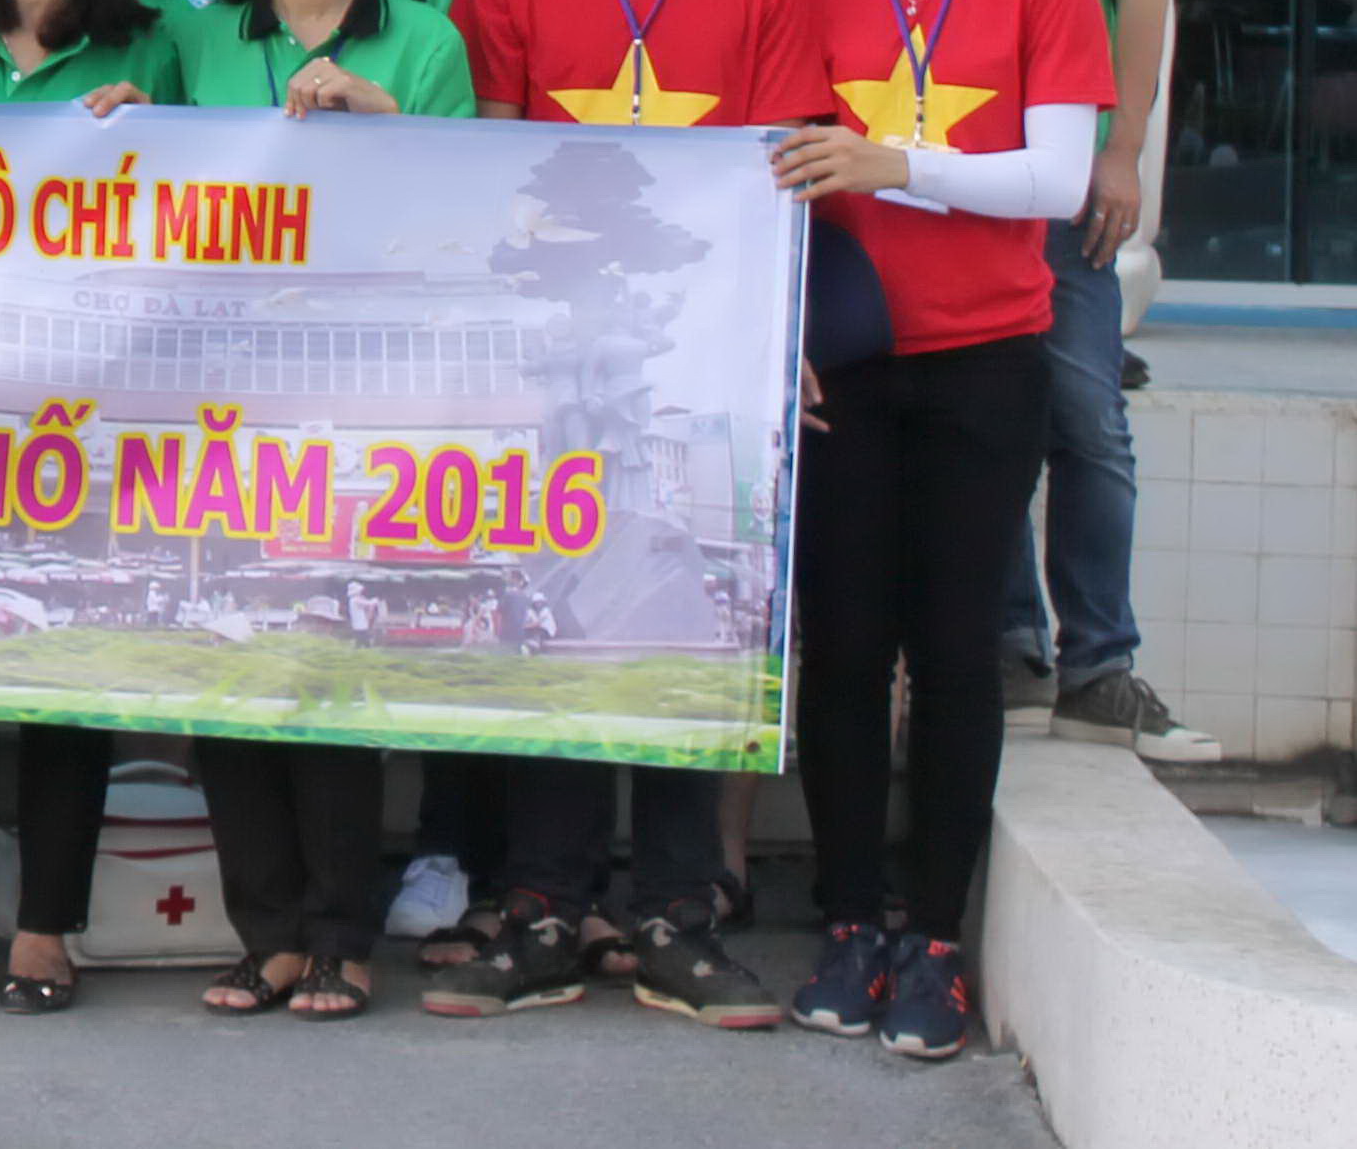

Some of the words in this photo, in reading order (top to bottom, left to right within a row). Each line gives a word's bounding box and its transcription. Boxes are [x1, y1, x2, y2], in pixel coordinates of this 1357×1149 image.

[31, 153, 138, 260] CHÍ
[153, 181, 312, 263] MINH
[117, 409, 329, 536] NĂM
[365, 445, 601, 553] 2016
